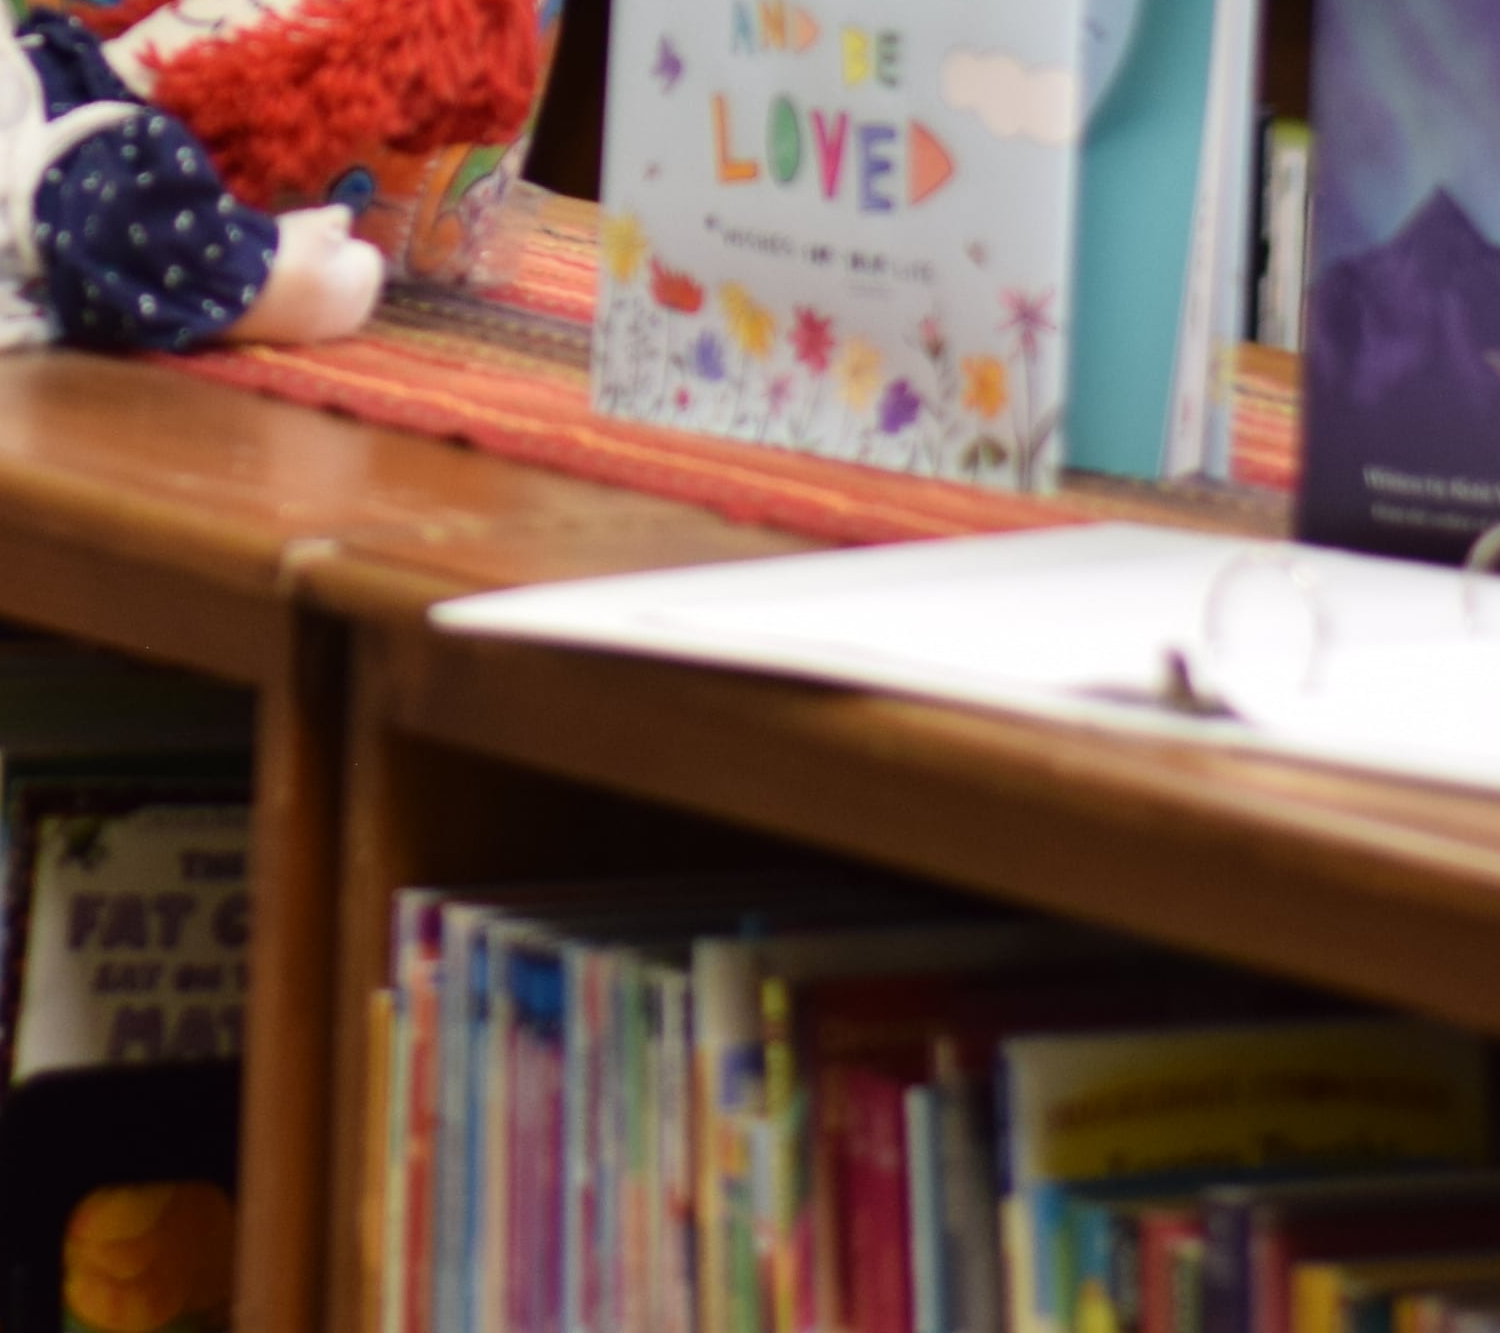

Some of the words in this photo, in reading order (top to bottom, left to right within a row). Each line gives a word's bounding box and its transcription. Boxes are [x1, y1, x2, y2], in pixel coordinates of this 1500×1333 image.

[841, 27, 900, 89] BE
[712, 94, 956, 214] LOVED
[67, 891, 196, 951] FAT
